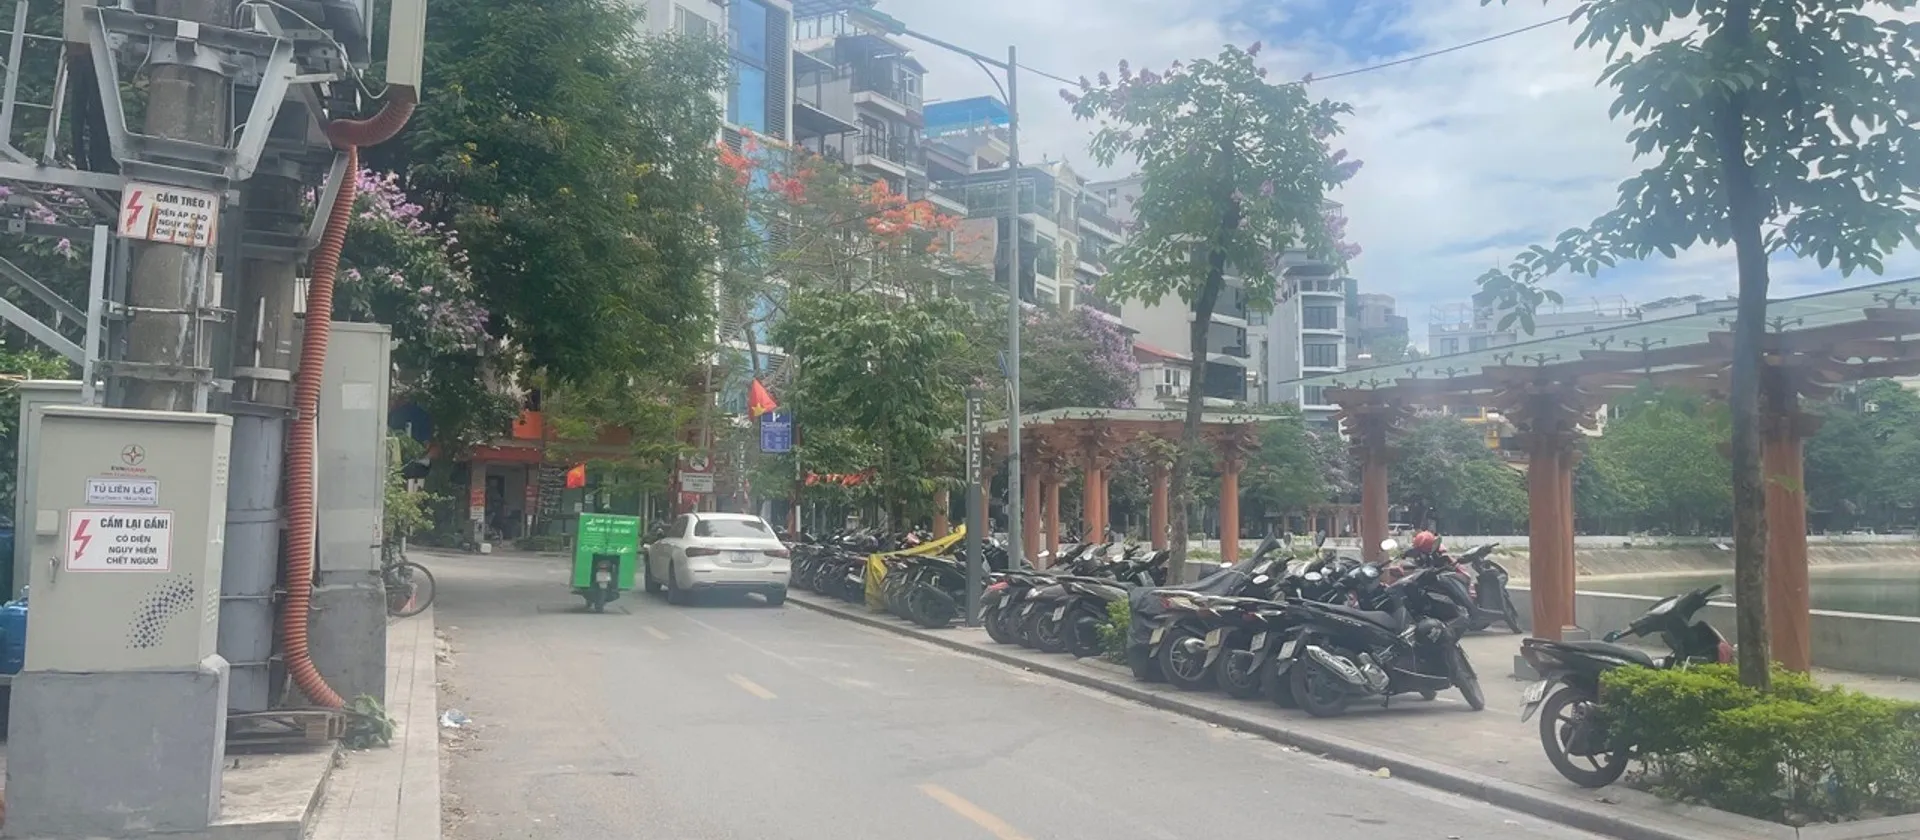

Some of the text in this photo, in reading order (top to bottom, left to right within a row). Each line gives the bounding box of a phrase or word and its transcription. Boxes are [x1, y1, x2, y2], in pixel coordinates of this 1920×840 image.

[156, 191, 178, 204] CẤM
[190, 212, 208, 222] CAO
[93, 483, 153, 496] TỦ LIÊN LẠC
[100, 514, 123, 529] CẤM
[125, 518, 141, 531] LẠI
[108, 546, 134, 554] NGUY
[106, 556, 159, 565] CHẾT NGƯỜI
